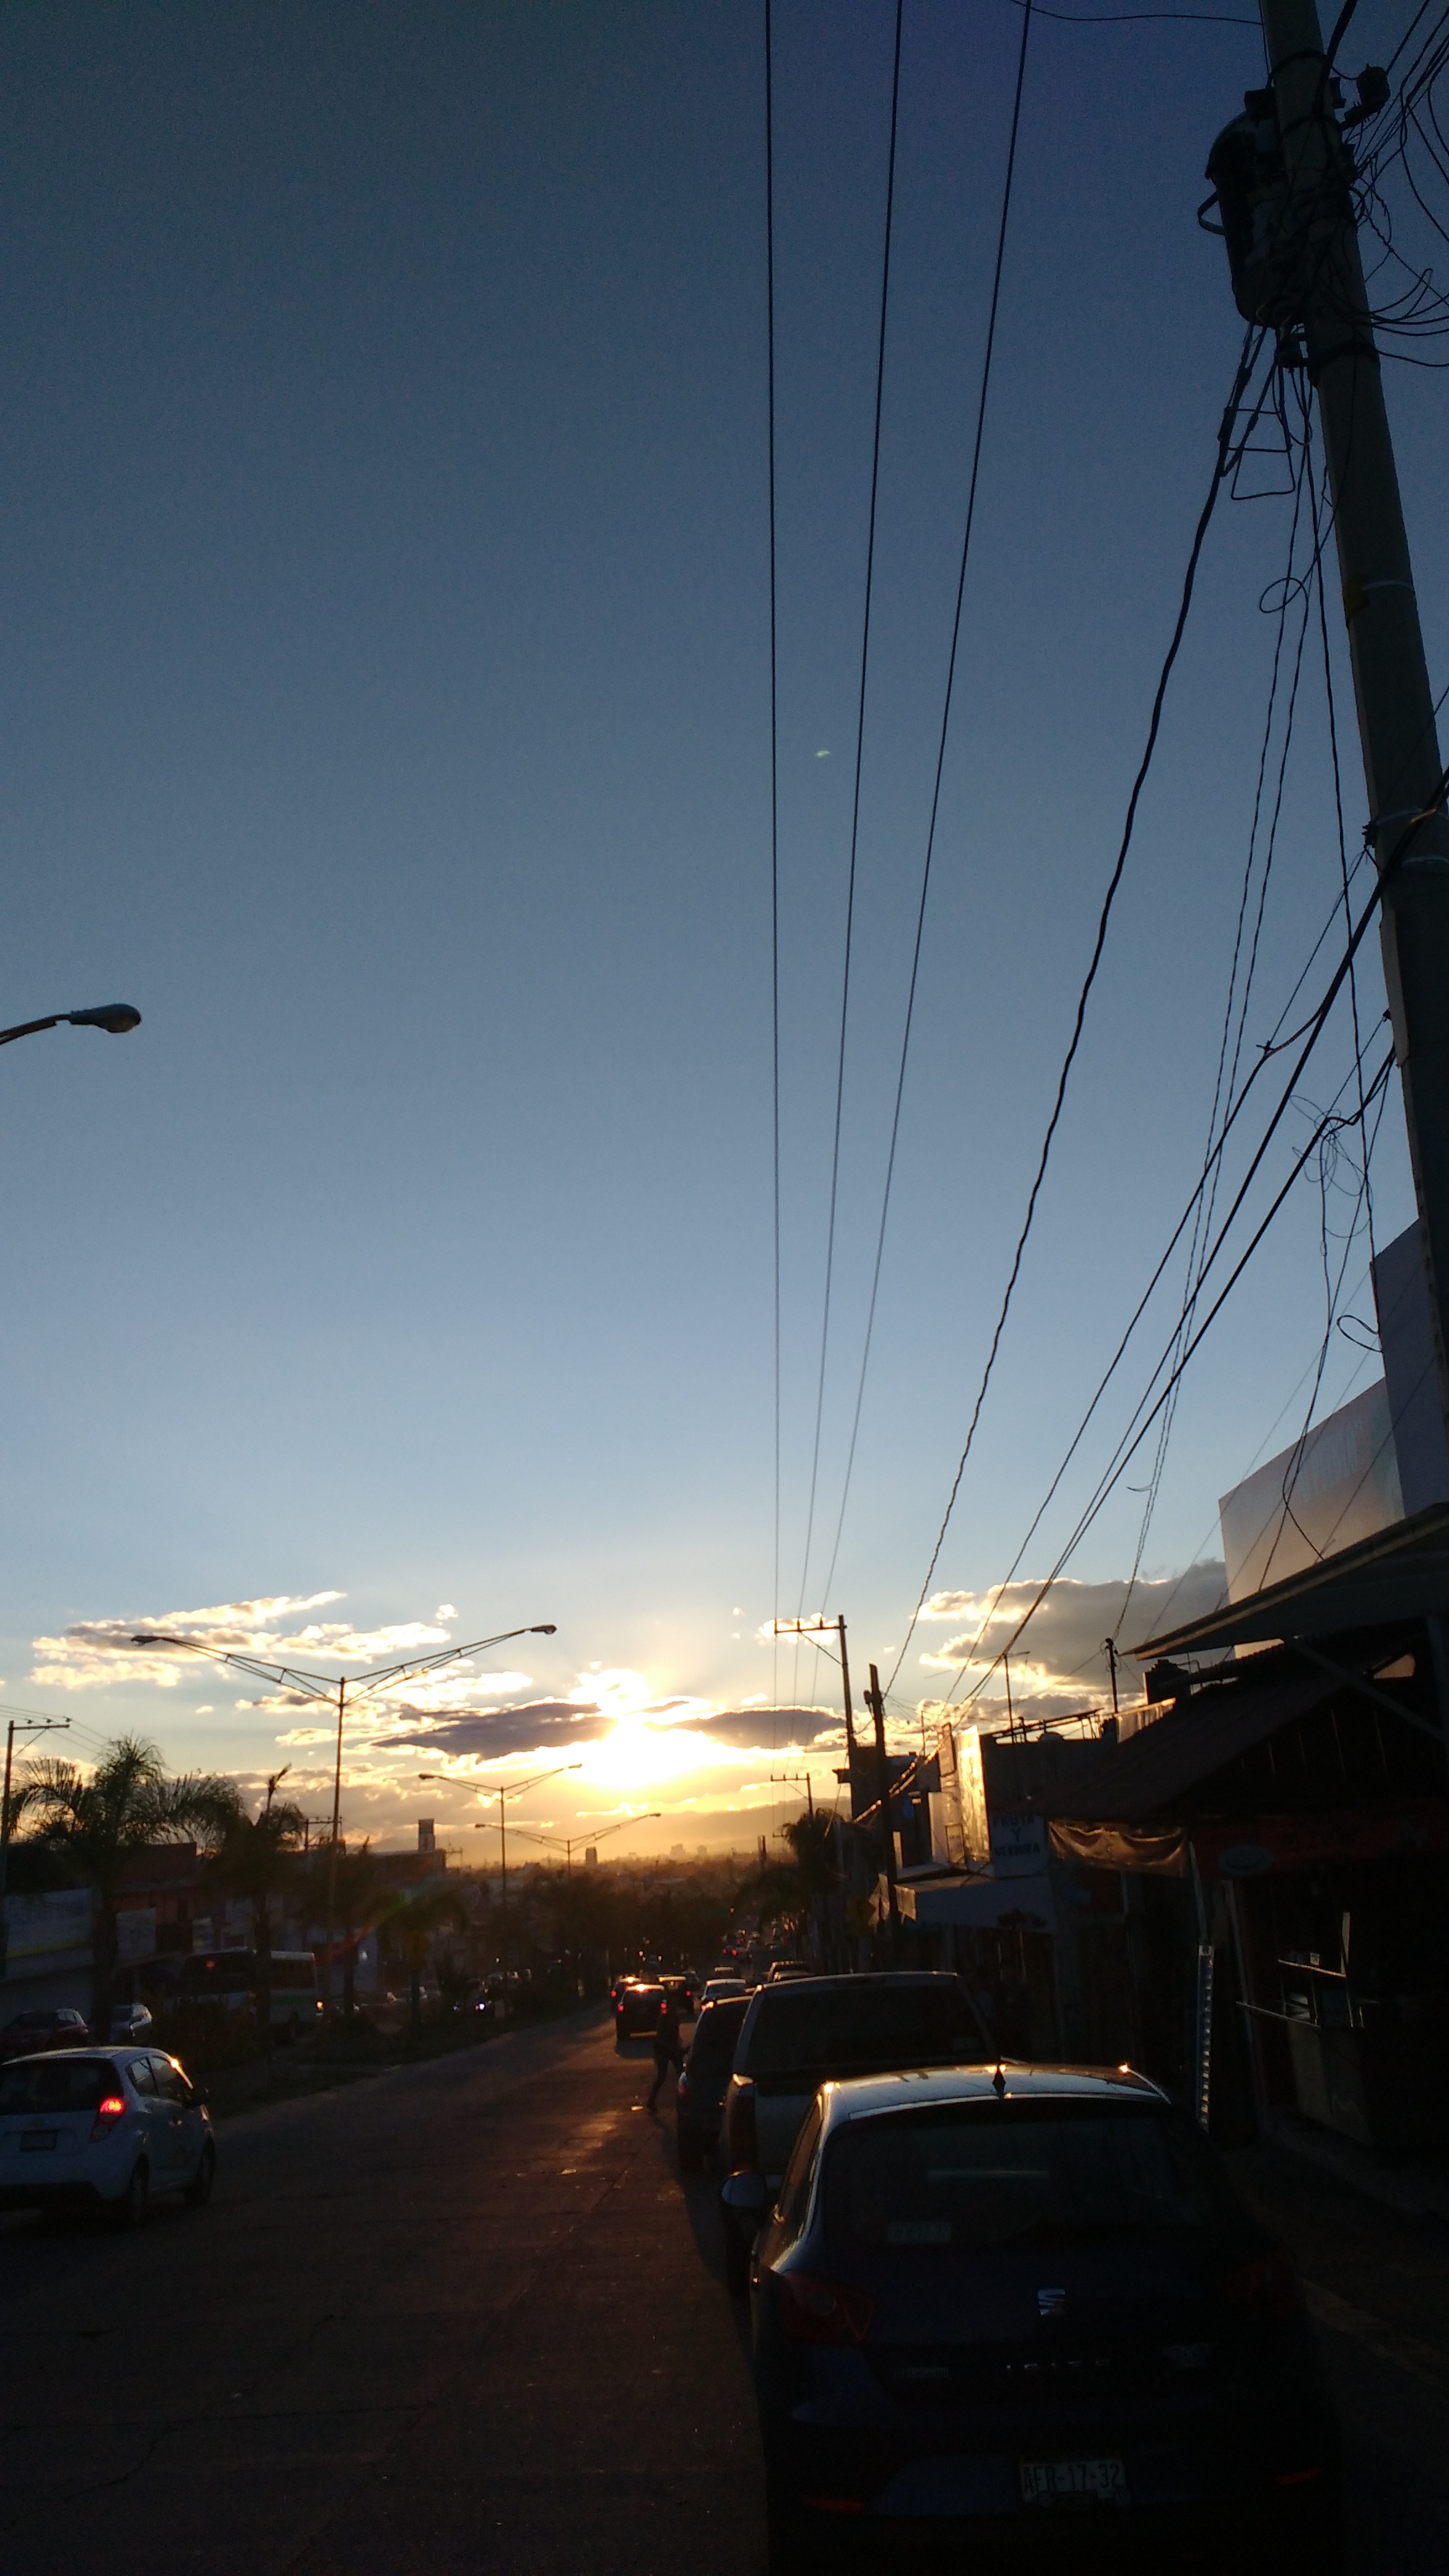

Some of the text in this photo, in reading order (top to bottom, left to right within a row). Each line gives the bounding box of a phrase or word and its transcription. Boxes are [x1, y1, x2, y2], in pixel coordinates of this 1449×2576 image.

[993, 1813, 1034, 1827] FRUTA
[1011, 1828, 1020, 1842] Y
[995, 1843, 1040, 1856] VERDURA
